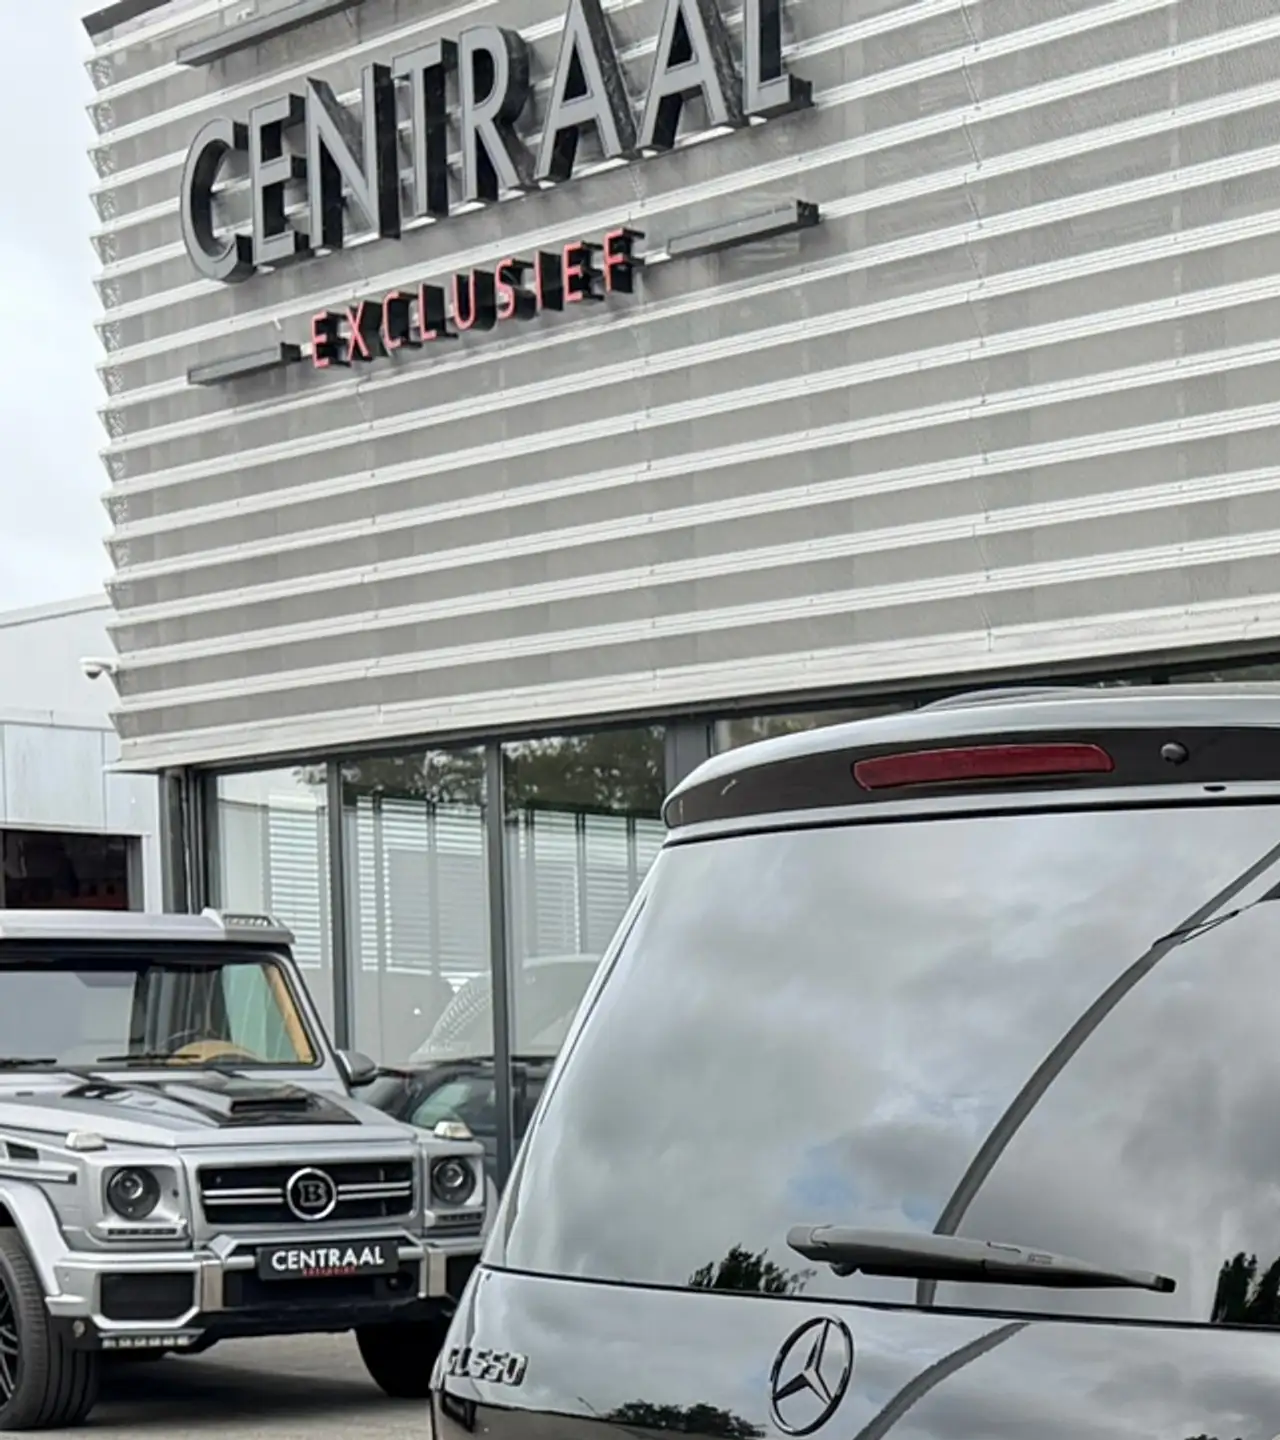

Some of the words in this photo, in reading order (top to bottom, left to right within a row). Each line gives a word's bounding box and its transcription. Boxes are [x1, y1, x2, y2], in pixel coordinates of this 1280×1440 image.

[181, 0, 812, 283] CENTRAAL
[310, 227, 642, 369] EXCLUSIEF
[271, 1246, 385, 1271] CENTRAAL
